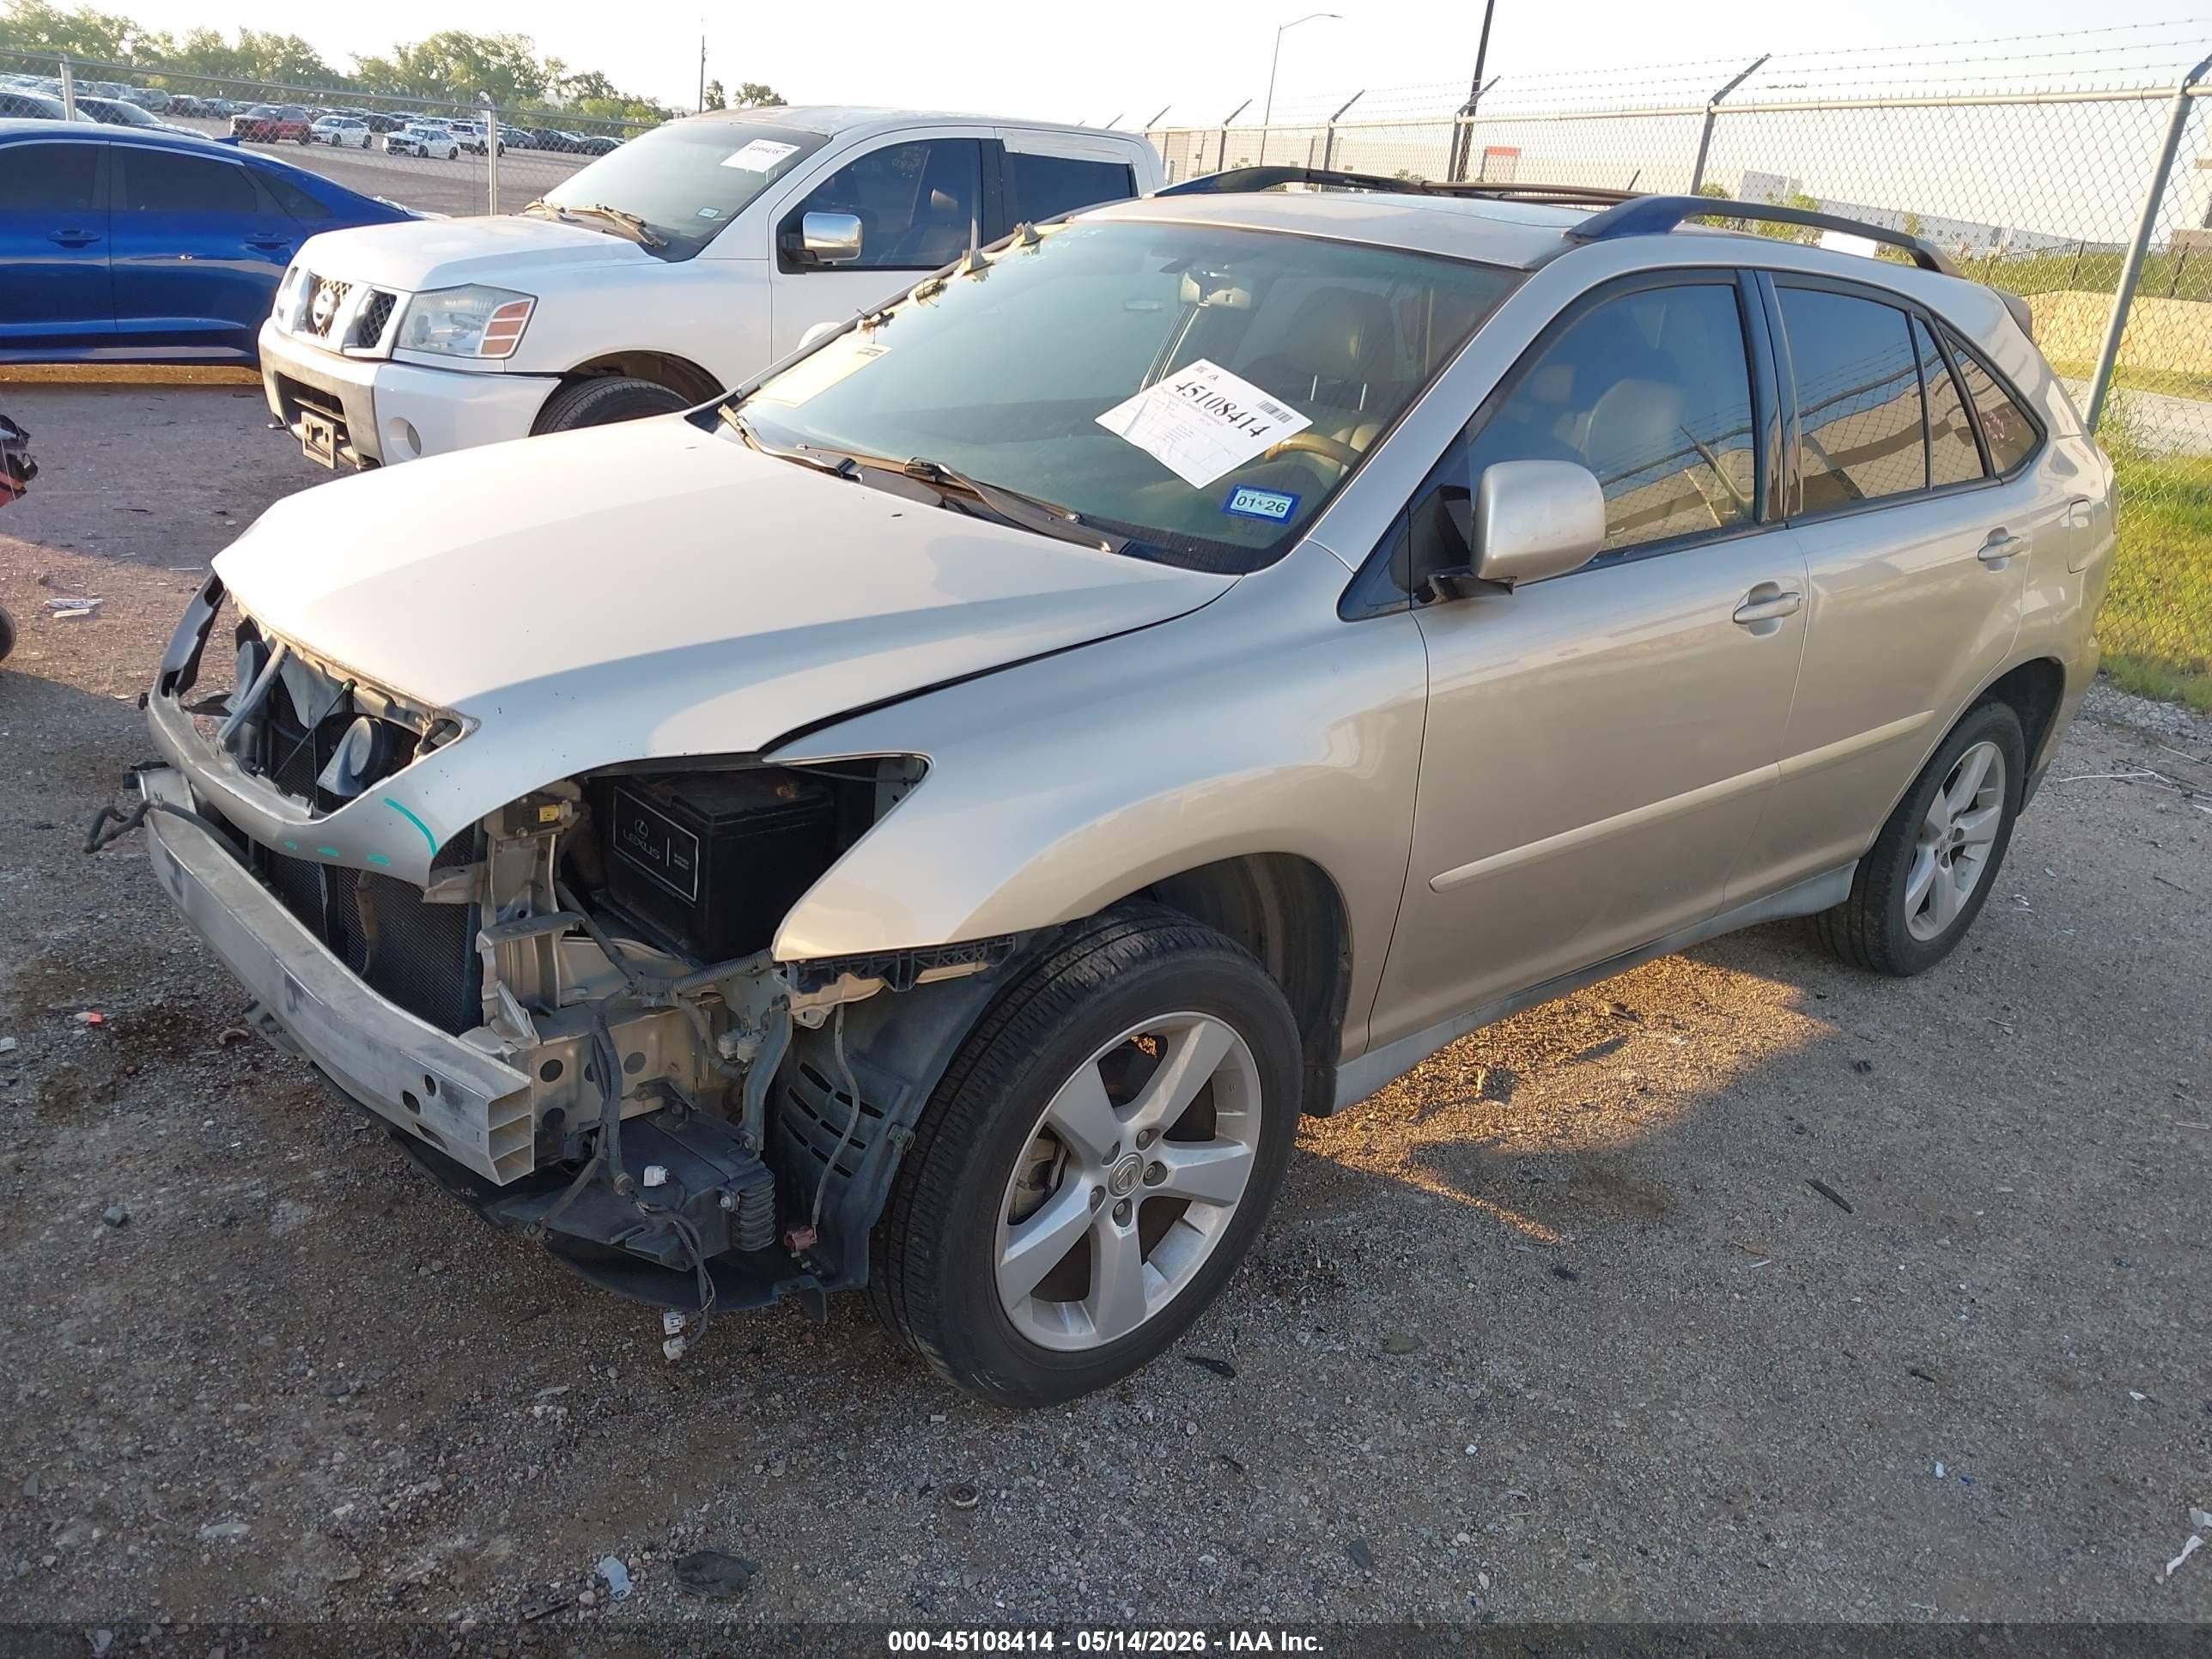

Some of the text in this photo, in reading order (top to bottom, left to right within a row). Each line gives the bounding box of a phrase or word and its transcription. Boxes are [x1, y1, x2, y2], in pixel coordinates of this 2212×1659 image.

[1175, 380, 1272, 438] 45108414
[1237, 495, 1287, 514] 01 26
[623, 828, 660, 860] LEXUS
